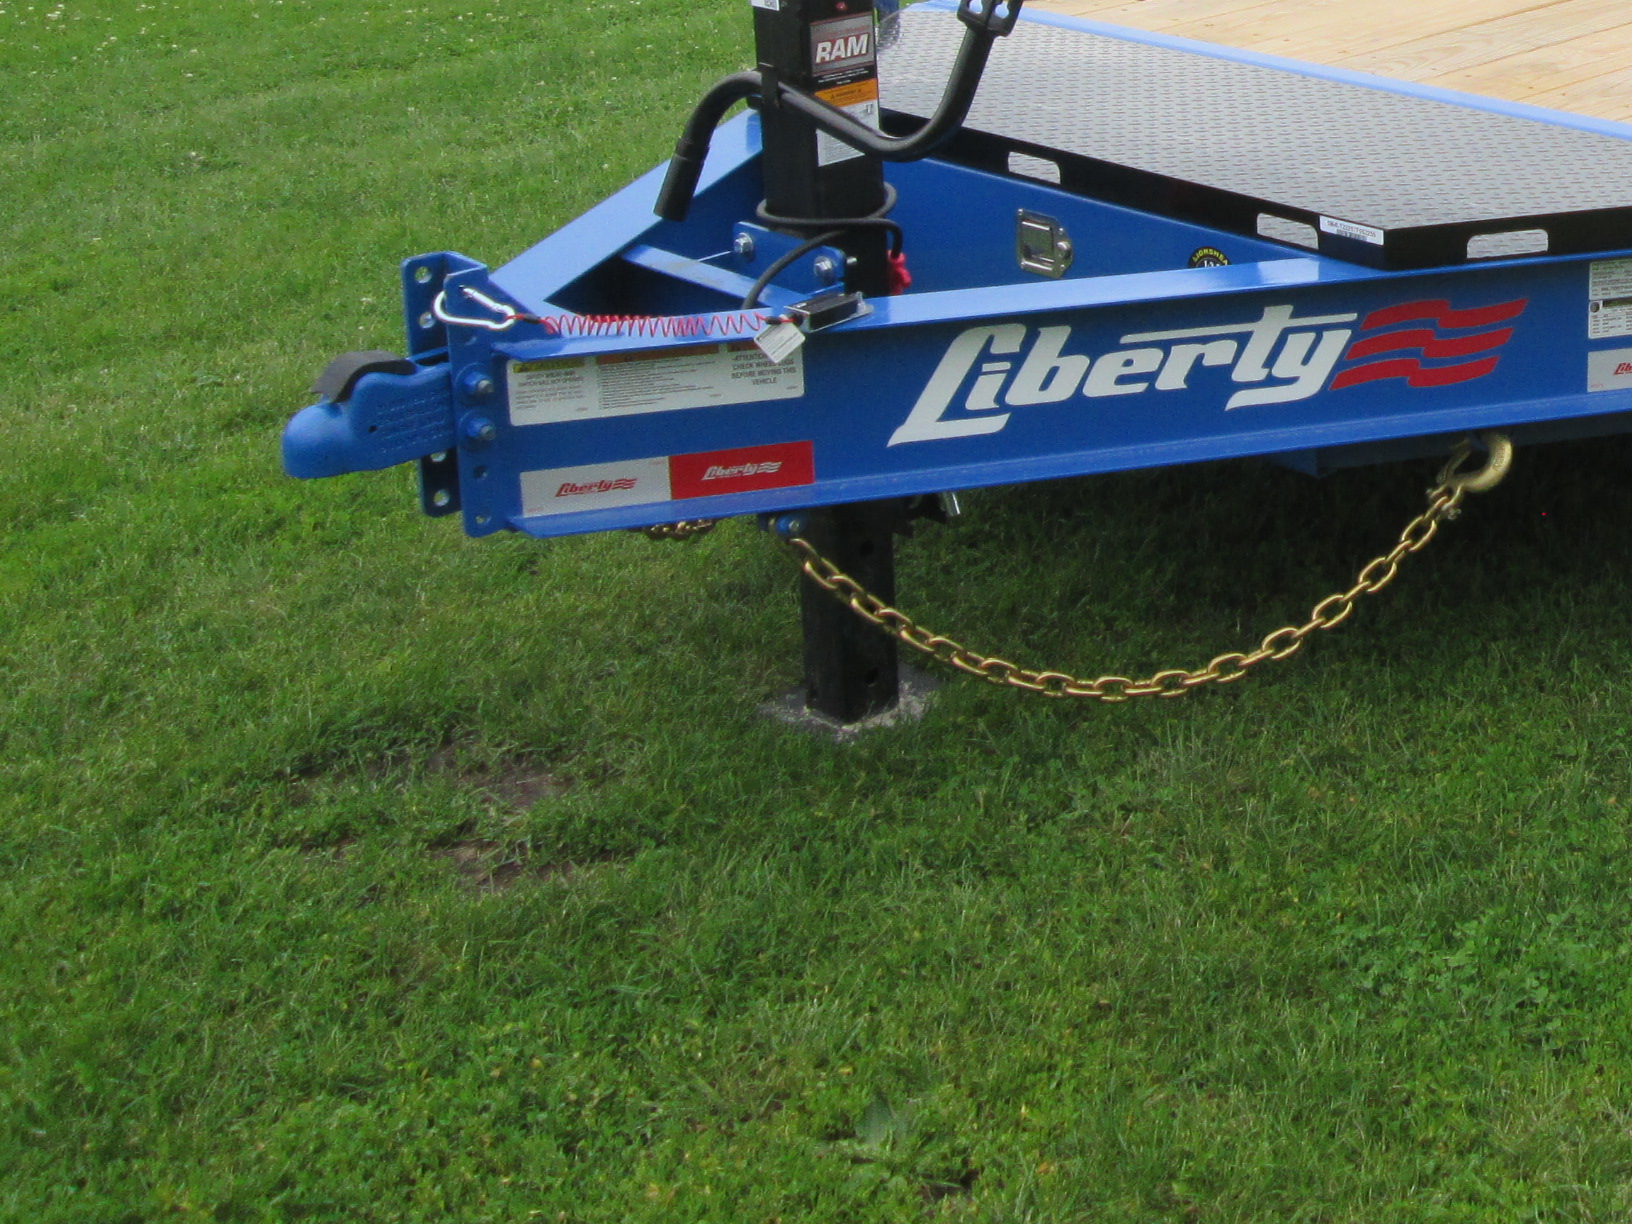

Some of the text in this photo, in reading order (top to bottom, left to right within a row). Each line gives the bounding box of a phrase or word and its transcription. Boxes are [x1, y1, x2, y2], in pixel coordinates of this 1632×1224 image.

[815, 33, 869, 64] RAM
[1192, 248, 1228, 266] LIONSHEA
[731, 366, 797, 379] BEFORE MOVING THIS
[752, 377, 778, 385] VEHICLE
[887, 304, 1358, 447] Liberty
[701, 462, 758, 481] Liberty
[555, 478, 613, 497] Liberty
